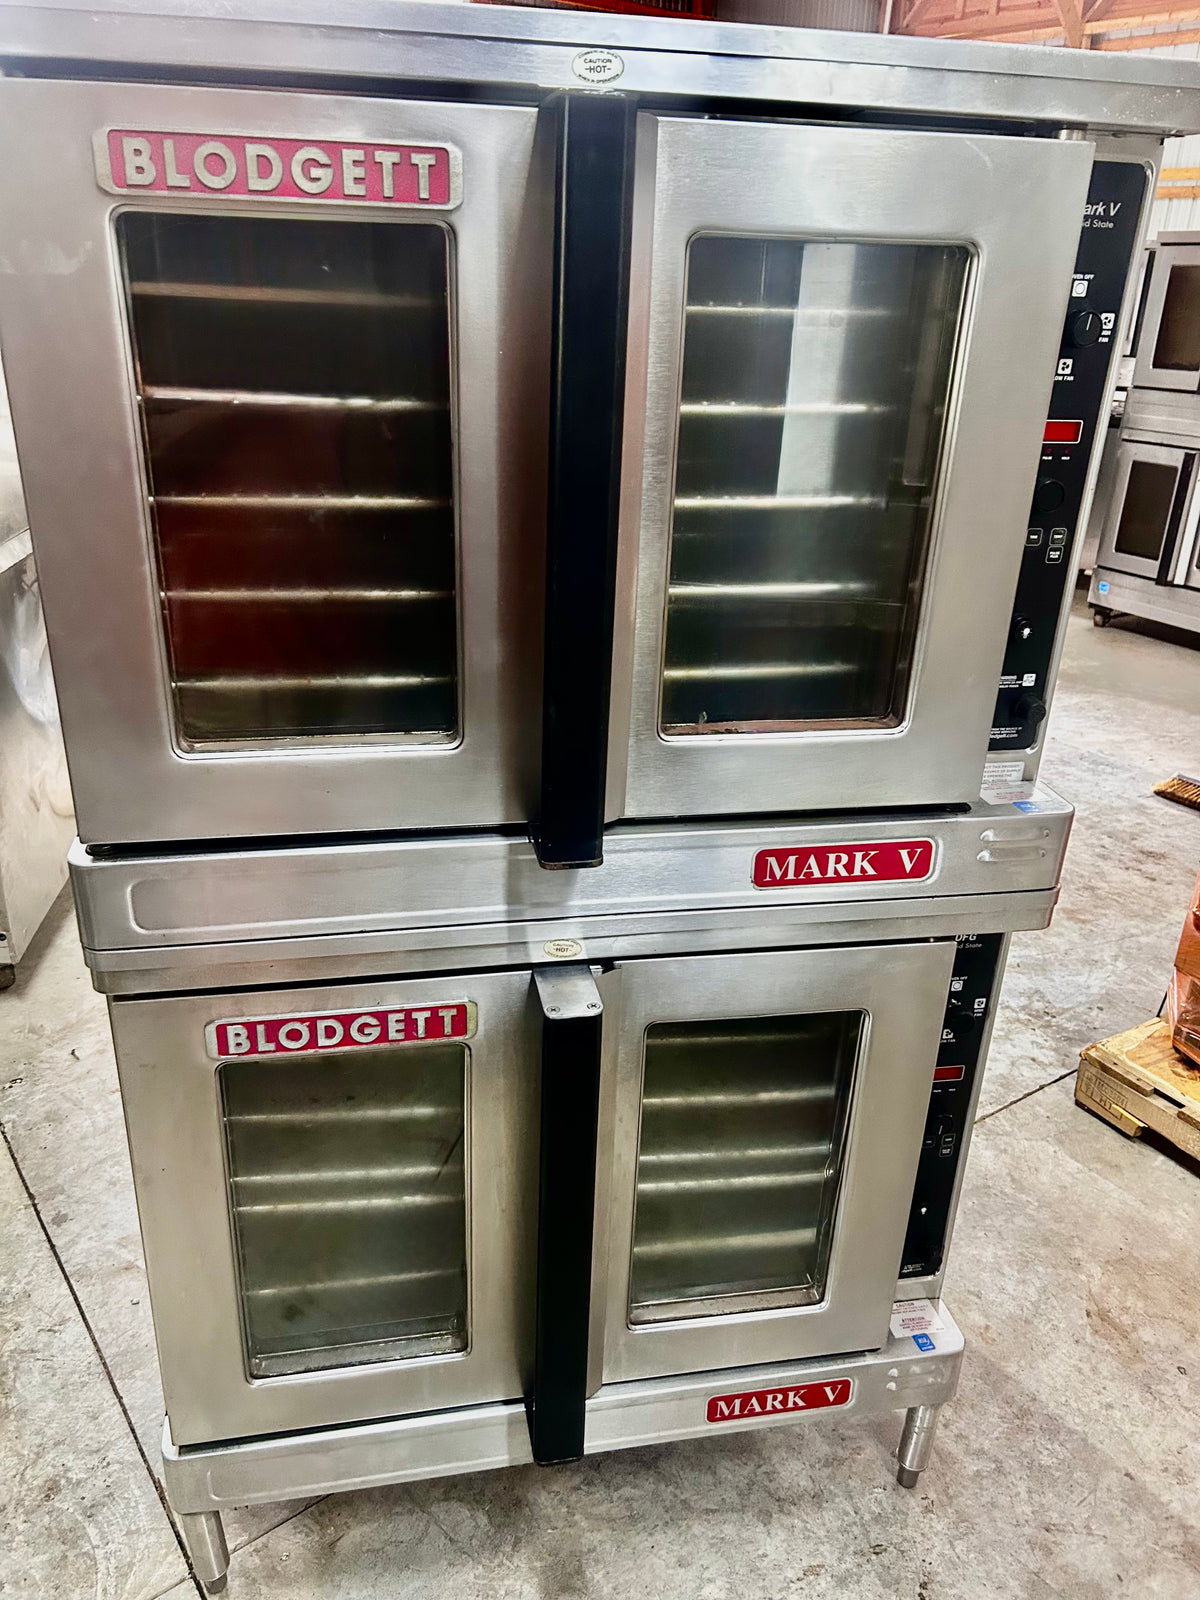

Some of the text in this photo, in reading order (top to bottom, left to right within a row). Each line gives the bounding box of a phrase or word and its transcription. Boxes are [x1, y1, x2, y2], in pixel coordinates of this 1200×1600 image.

[122, 137, 437, 199] BLODGETT
[1084, 201, 1122, 217] ark V
[1092, 219, 1114, 229] State
[763, 848, 923, 881] MARK V
[226, 1008, 458, 1055] BLODGETT
[714, 1384, 843, 1418] MARK V
